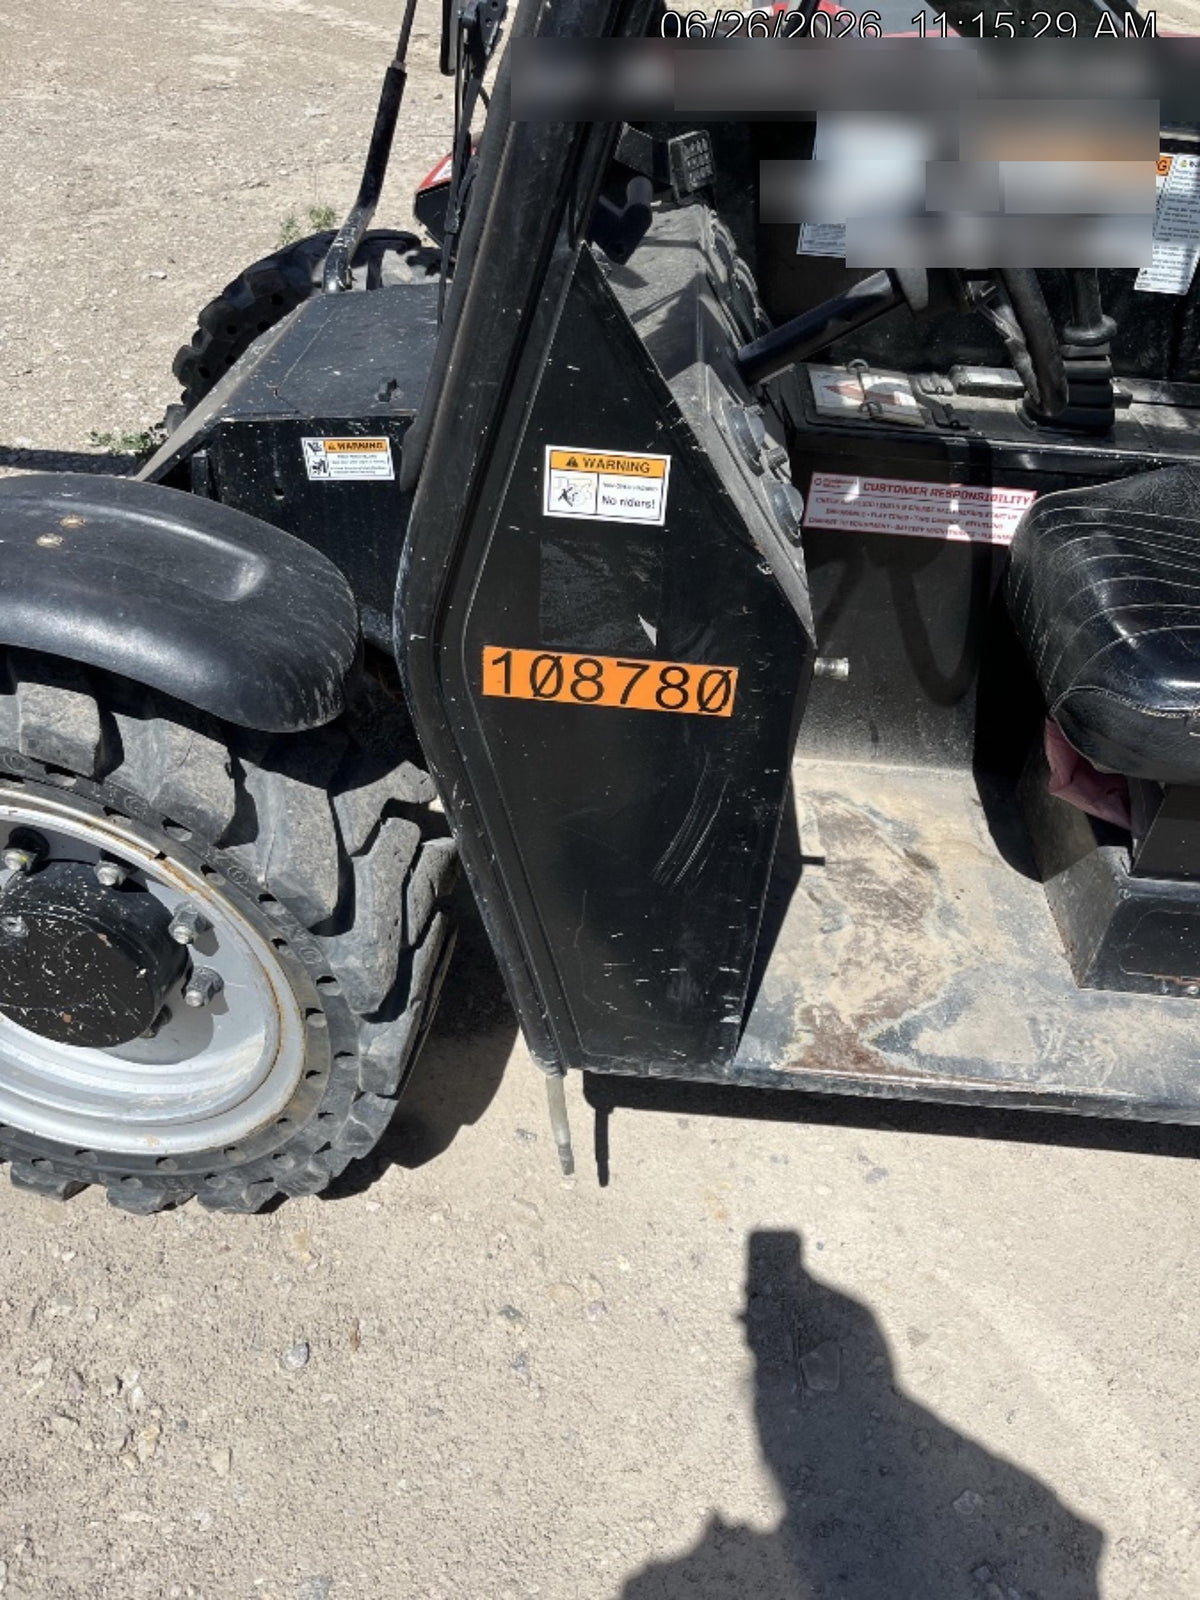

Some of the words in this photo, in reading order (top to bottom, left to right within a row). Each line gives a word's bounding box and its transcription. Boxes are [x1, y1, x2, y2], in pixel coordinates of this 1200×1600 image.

[336, 442, 384, 450] WARNING
[582, 457, 651, 474] WARNING
[601, 495, 618, 506] No
[619, 497, 656, 509] riders!
[863, 482, 928, 497] CUSTOMER
[930, 487, 1031, 506] RESPONSIBILITY
[491, 650, 733, 714] 108780
